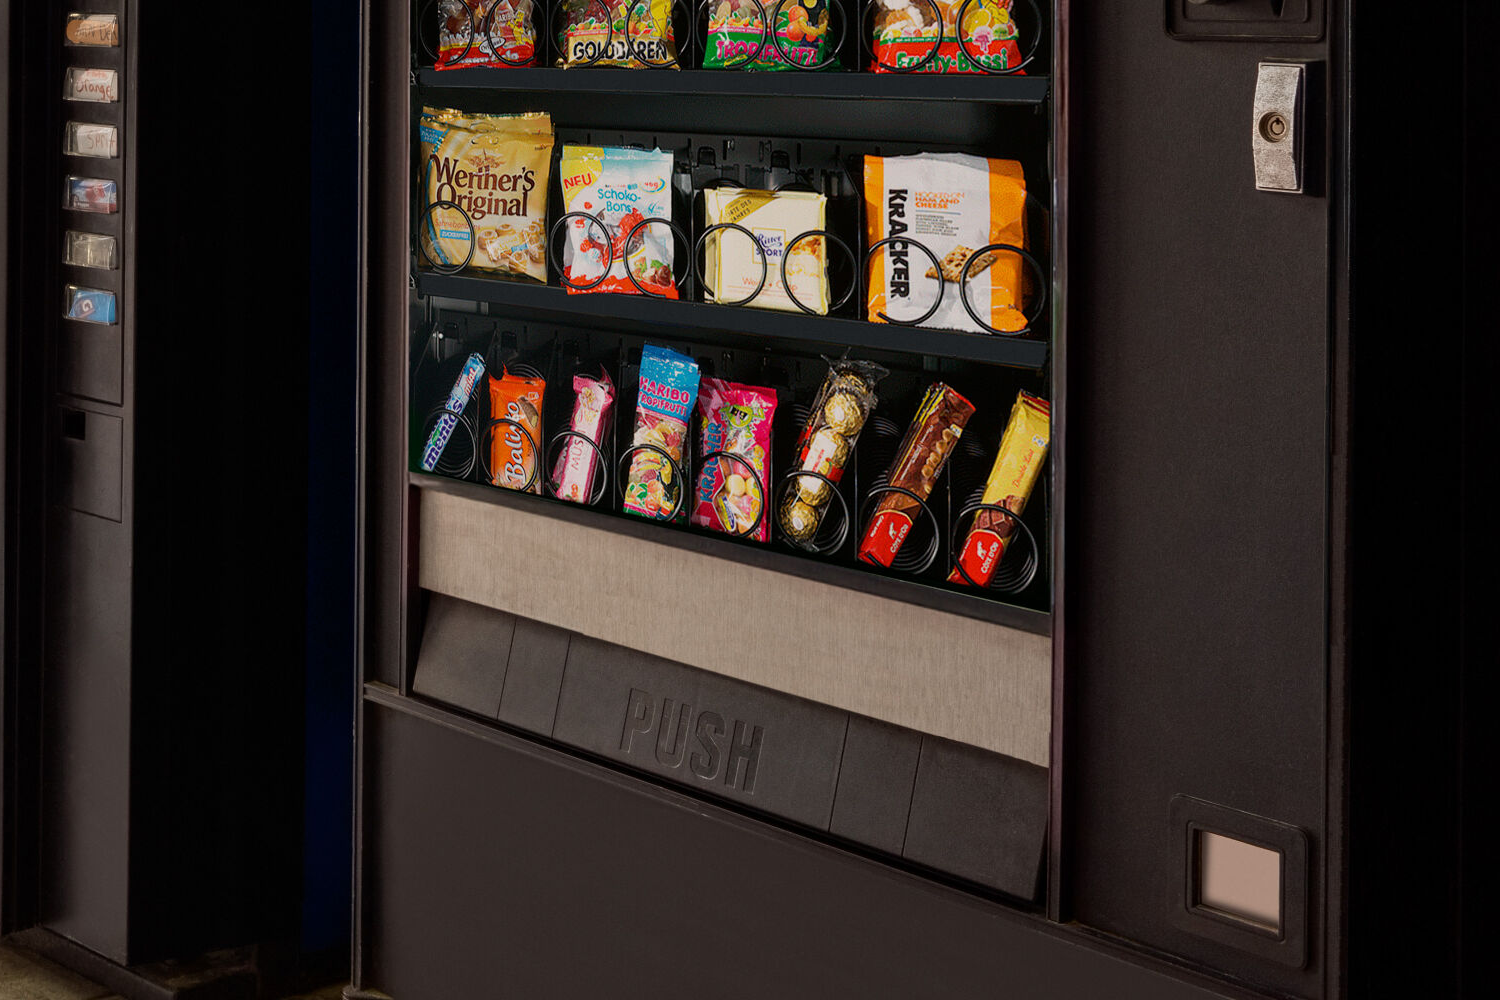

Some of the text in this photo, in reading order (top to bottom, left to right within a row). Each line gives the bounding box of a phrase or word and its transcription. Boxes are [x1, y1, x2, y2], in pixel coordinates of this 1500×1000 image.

[430, 153, 536, 193] Werther's
[436, 182, 528, 221] Original
[598, 188, 642, 202] Schoko-
[606, 200, 632, 213] Bons
[755, 247, 784, 257] SPORT
[888, 188, 911, 299] KRACKER
[639, 376, 691, 404] HARIBO
[422, 399, 463, 470] mentos
[568, 428, 586, 471] MÜSI
[619, 687, 765, 796] PUSH
